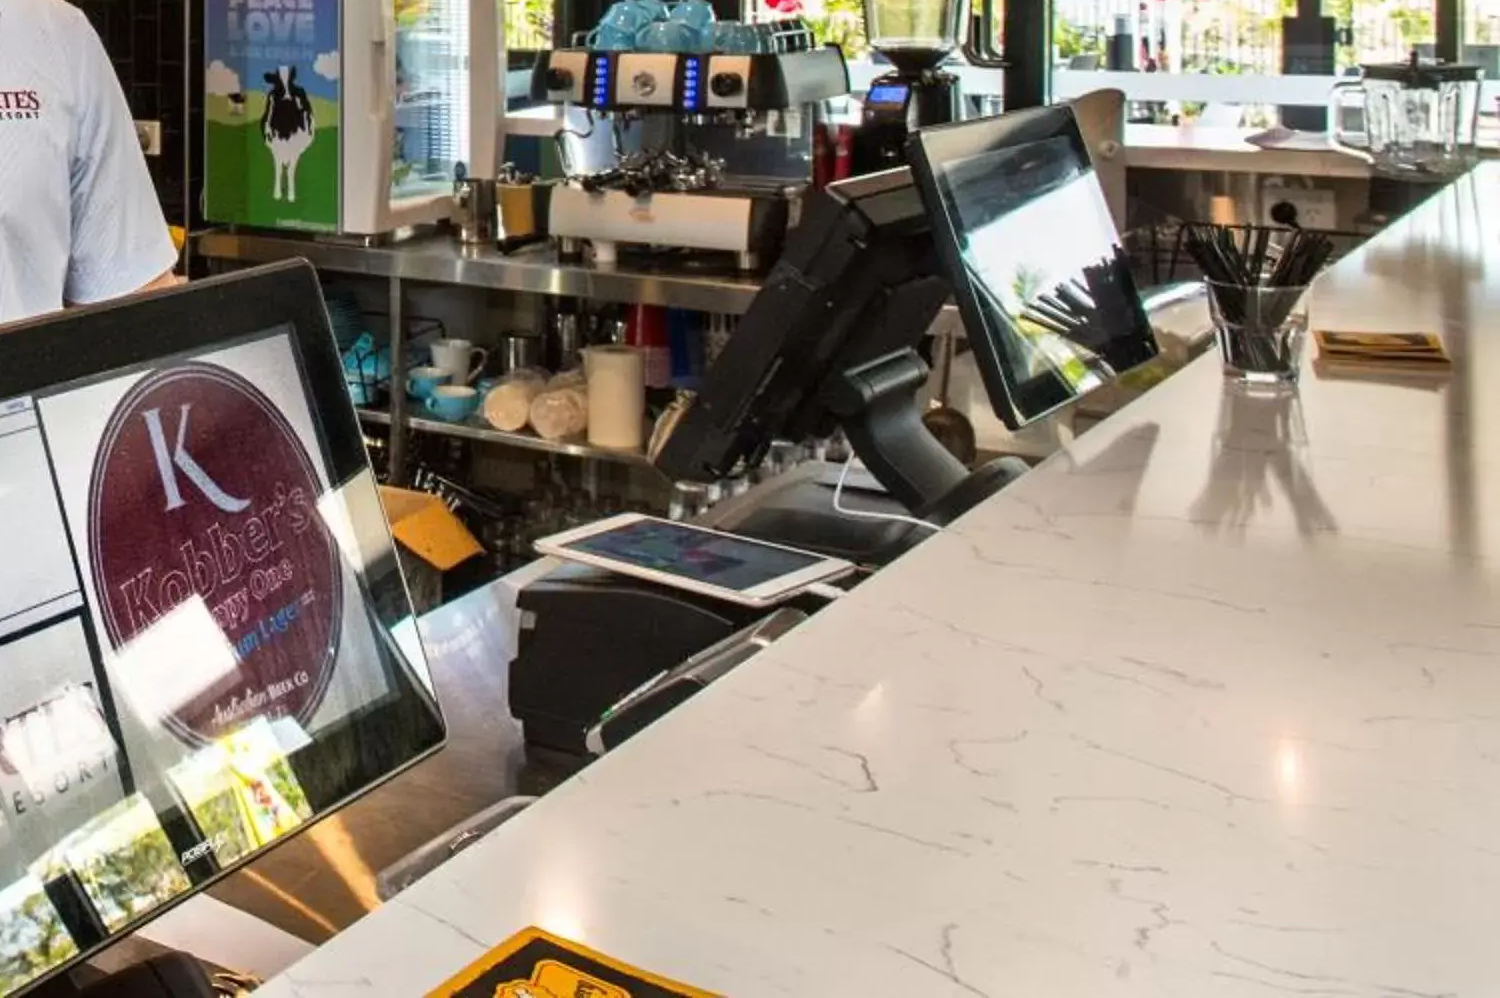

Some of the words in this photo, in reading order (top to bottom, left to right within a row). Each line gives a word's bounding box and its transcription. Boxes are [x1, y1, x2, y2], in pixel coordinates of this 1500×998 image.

[227, 11, 316, 43] LOVE
[141, 403, 252, 513] K
[119, 481, 311, 634] Kobber's
[249, 557, 294, 602] One
